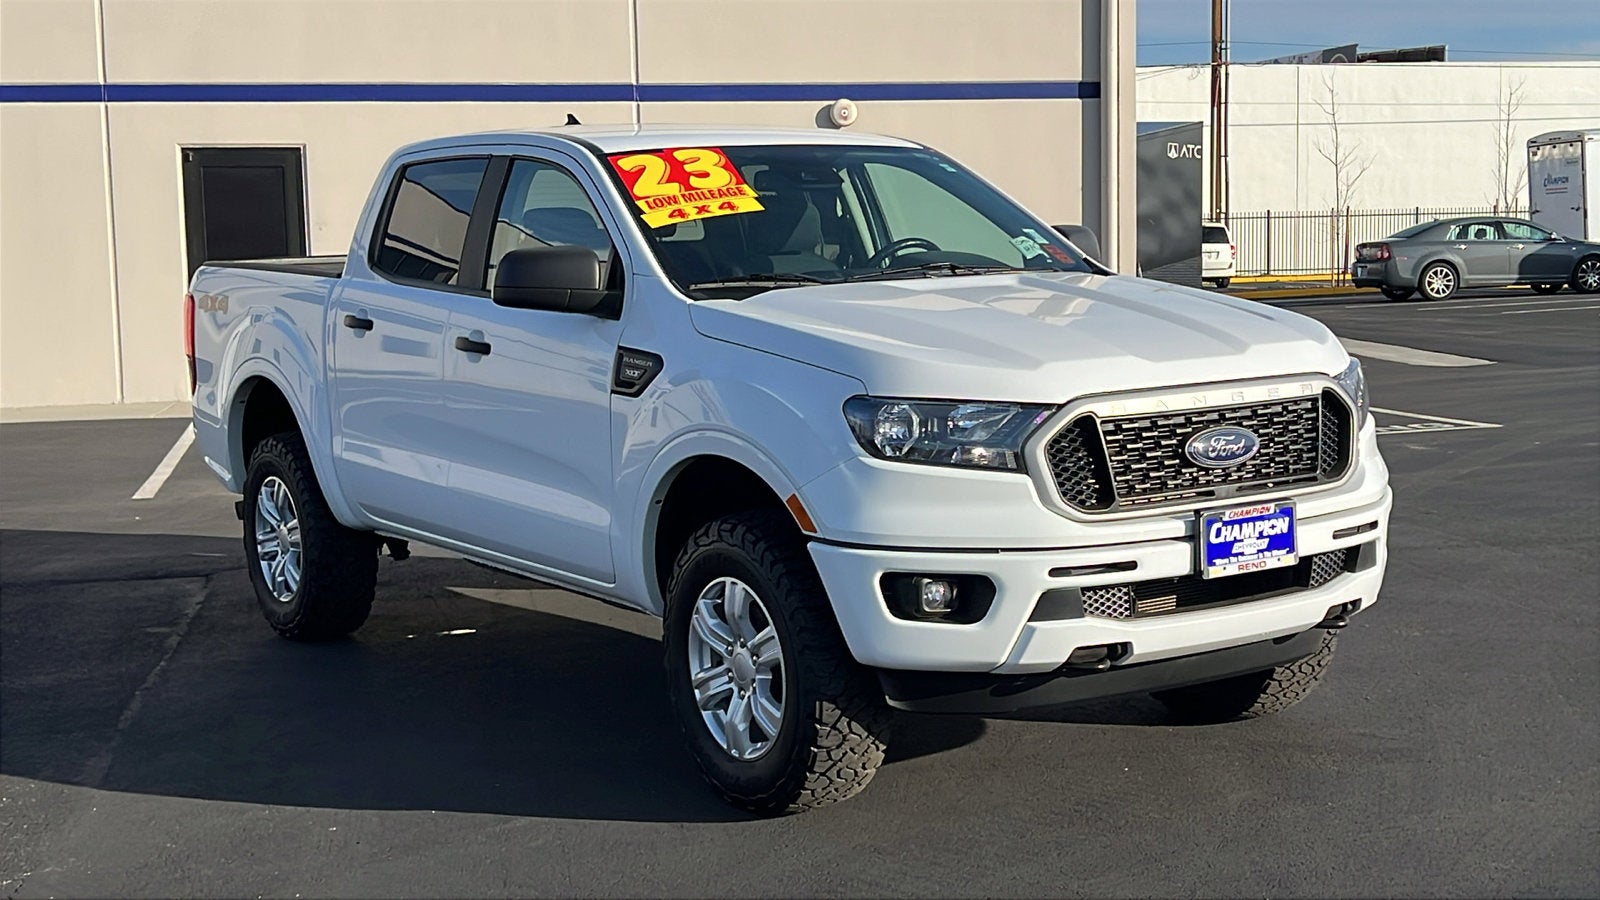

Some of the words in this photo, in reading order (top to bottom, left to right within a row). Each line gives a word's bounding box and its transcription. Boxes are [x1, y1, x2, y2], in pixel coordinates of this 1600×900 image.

[1180, 144, 1202, 159] ATC
[617, 148, 737, 197] 23
[645, 194, 680, 210] LOW
[682, 186, 747, 203] MILEAGE
[623, 356, 653, 367] RANGER
[1208, 436, 1245, 458] Ford
[1229, 506, 1271, 519] CHAMPION
[1209, 516, 1290, 544] CHAMPION
[1237, 560, 1267, 572] RENO
